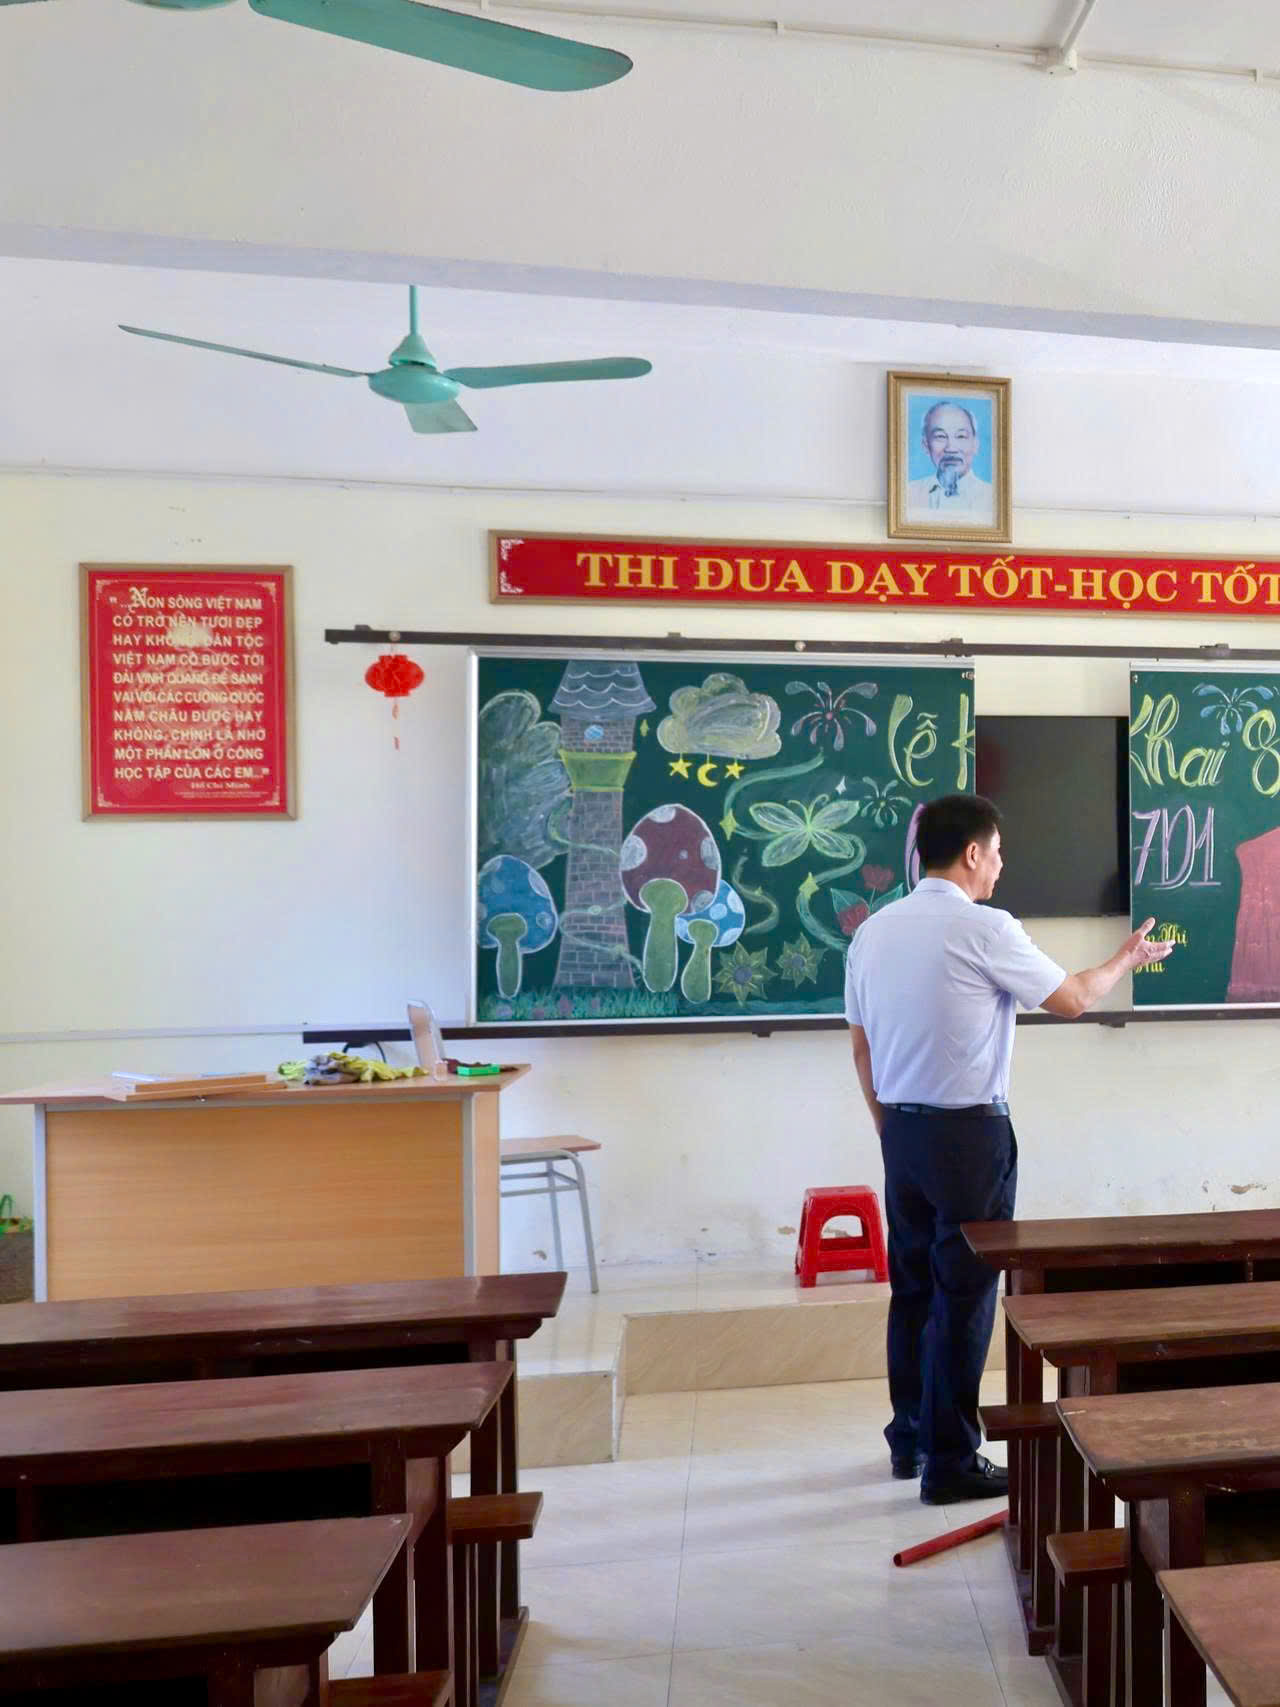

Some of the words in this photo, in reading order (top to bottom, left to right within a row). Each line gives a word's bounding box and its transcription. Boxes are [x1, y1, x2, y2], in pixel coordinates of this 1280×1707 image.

[576, 552, 679, 589] THI
[693, 557, 814, 593] ĐUA
[826, 561, 937, 603] DẠY
[948, 555, 1178, 609] TỐT-HỌC
[167, 594, 203, 609] SÔNG
[205, 595, 232, 612] VIỆT
[235, 598, 263, 609] NAM
[235, 616, 263, 631] ĐẸP
[112, 633, 142, 646] HAY
[235, 633, 264, 649] TỘC
[112, 651, 143, 668] VIỆT
[146, 653, 176, 665] NAM
[114, 745, 143, 763] MỘT
[226, 746, 264, 760] CÔNG
[114, 767, 143, 782] HỌC
